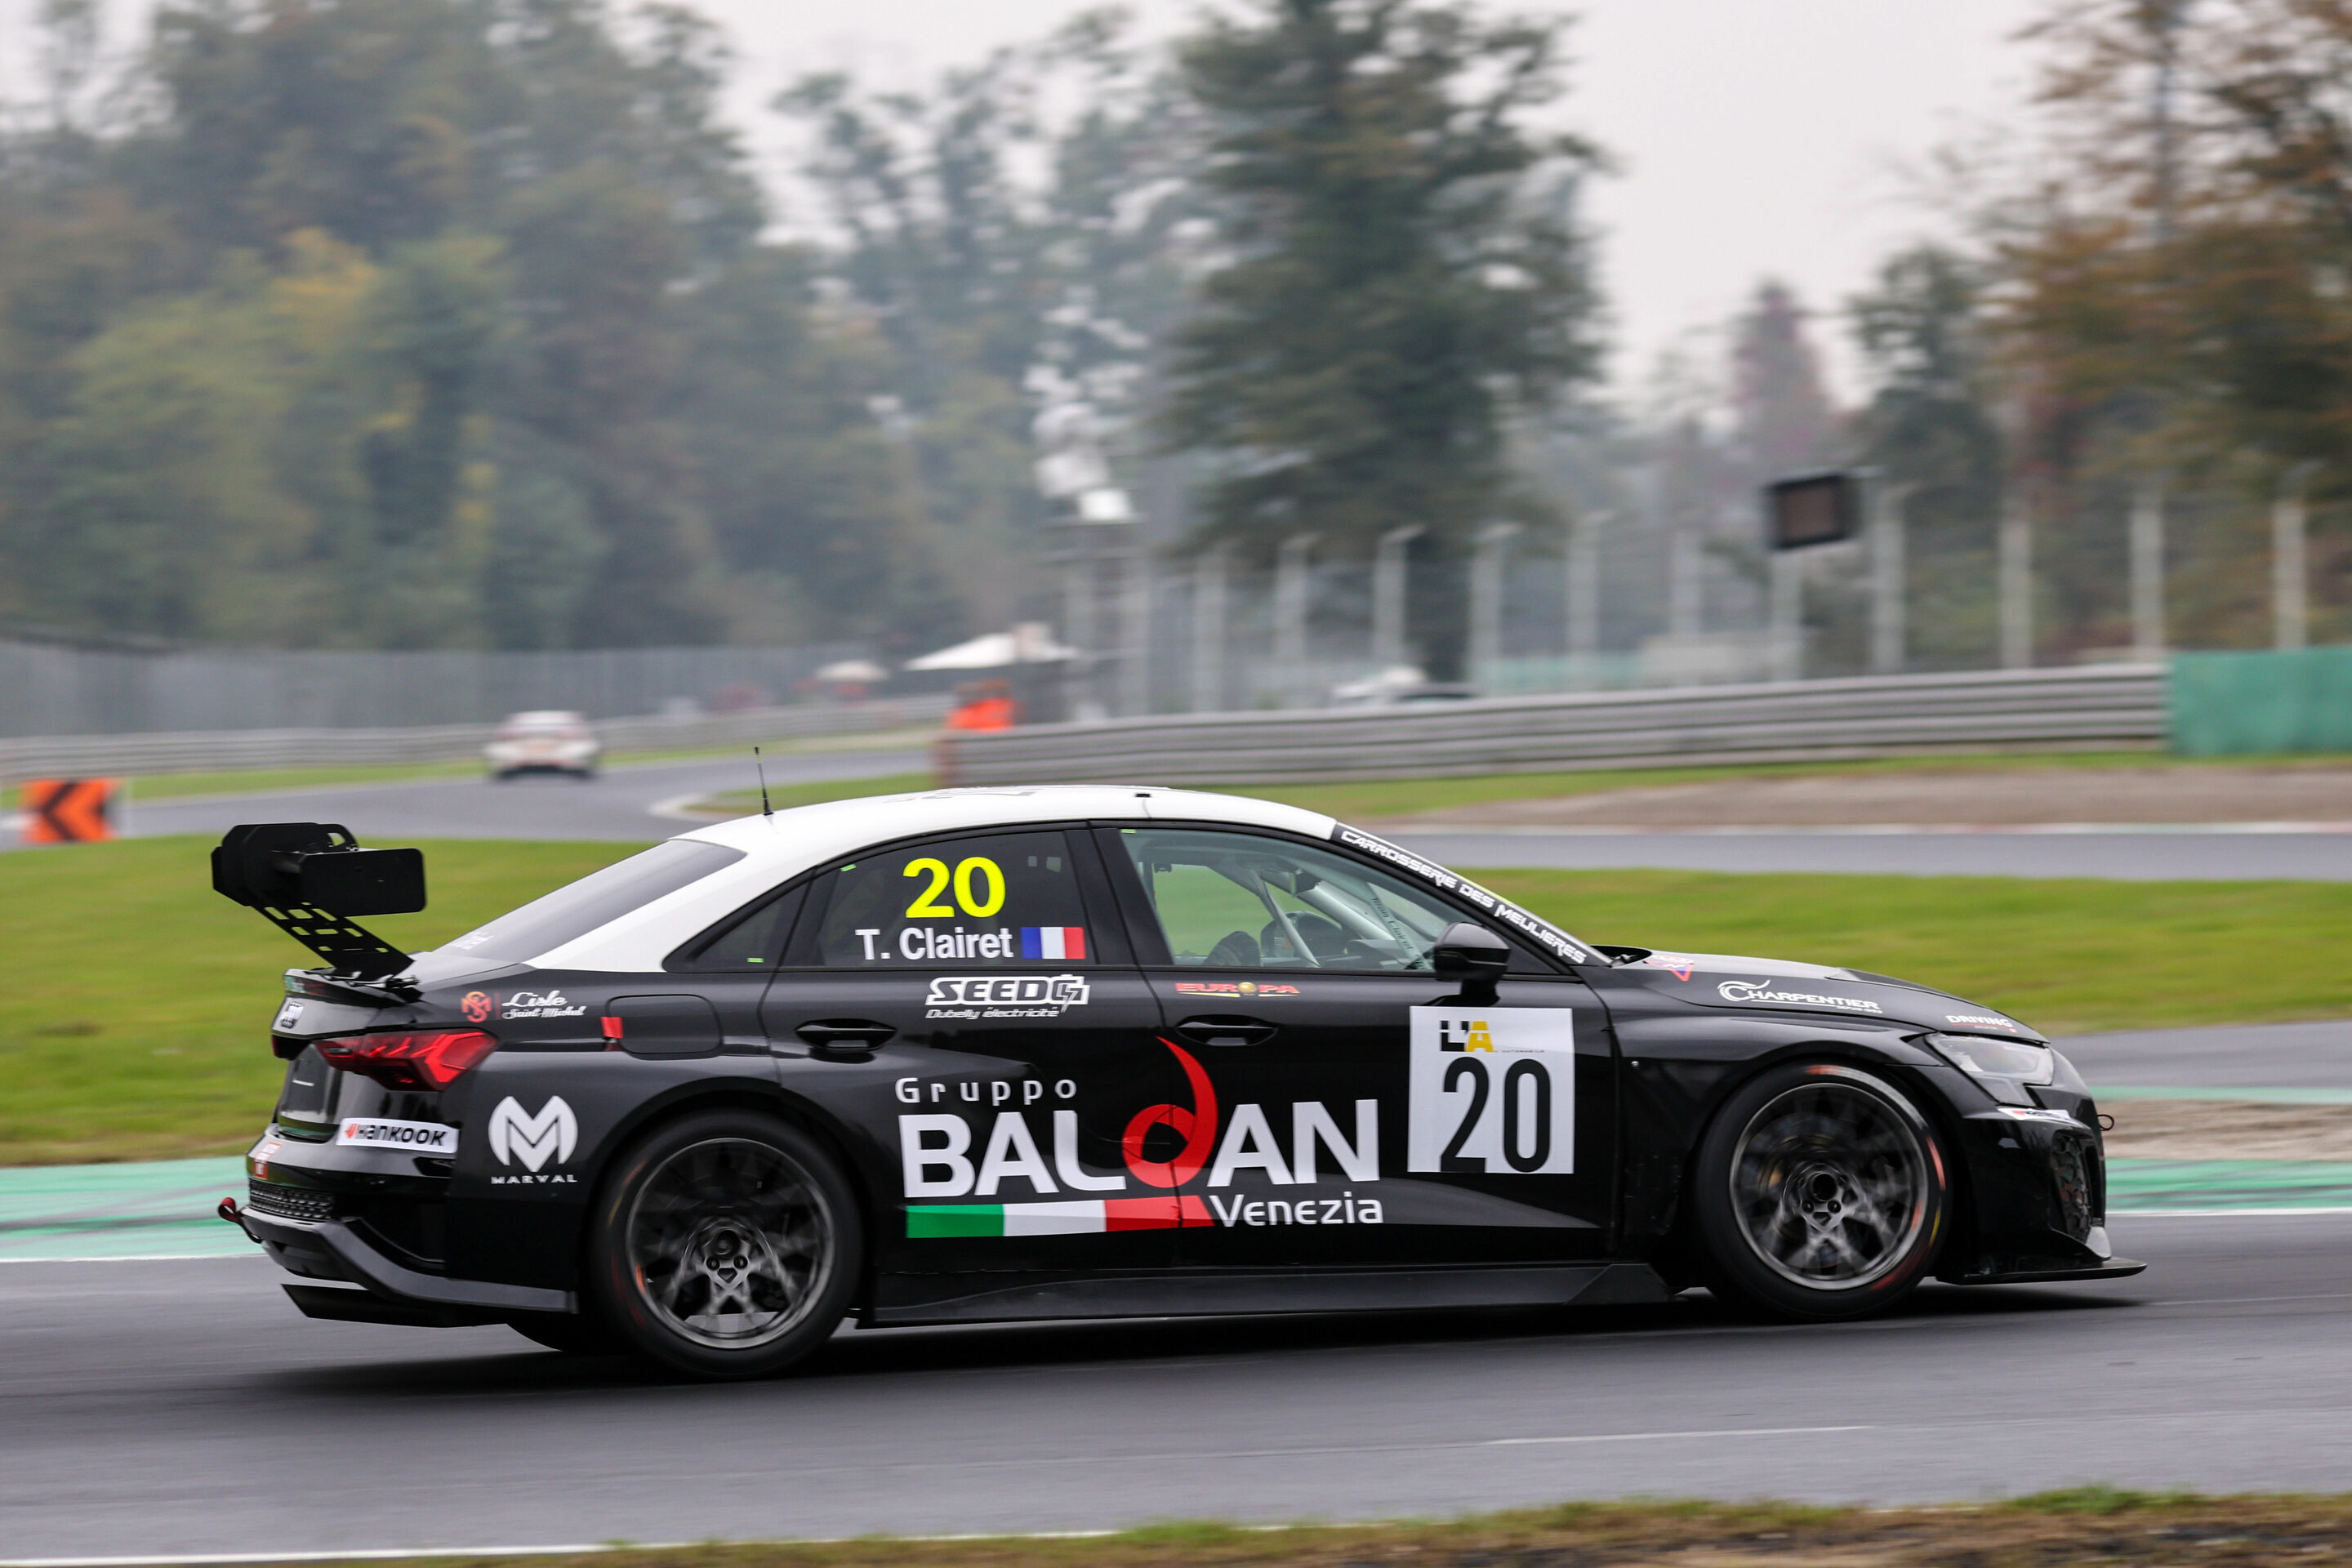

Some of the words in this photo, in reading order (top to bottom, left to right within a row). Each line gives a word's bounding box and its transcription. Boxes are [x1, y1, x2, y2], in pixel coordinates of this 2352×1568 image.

[1340, 830, 1458, 888] CARROSSERIE
[1459, 884, 1495, 908] DES
[902, 856, 1006, 919] 20
[855, 929, 891, 960] T.
[898, 926, 1014, 960] Clairet
[1174, 982, 1300, 995] EUROPA
[1717, 980, 1880, 1009] CHARPENTIER
[1945, 1015, 2013, 1027] DRIVING
[894, 1076, 1077, 1107] Gruppo
[1440, 1056, 1551, 1174] 20
[491, 1174, 578, 1184] MARVAL
[1208, 1191, 1383, 1227] Venezia
